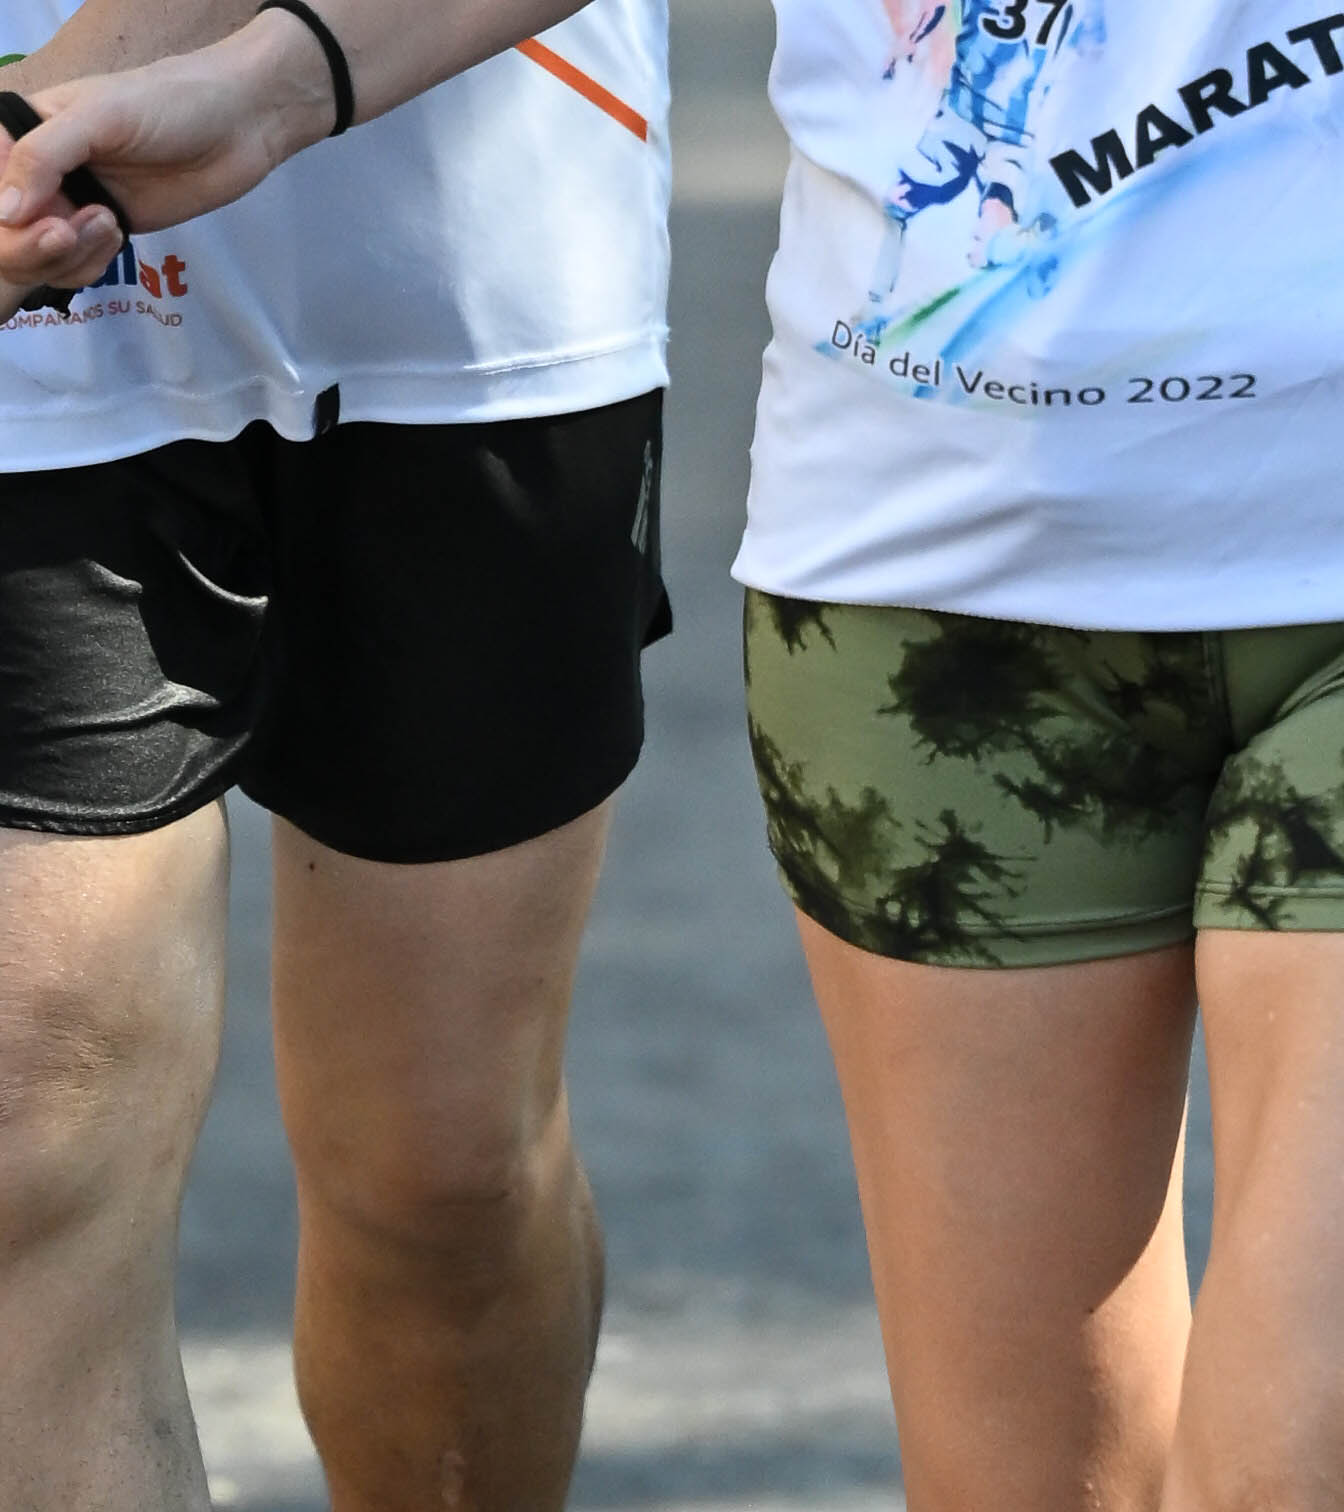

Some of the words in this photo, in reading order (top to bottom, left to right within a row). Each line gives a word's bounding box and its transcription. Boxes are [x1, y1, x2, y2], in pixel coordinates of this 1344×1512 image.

[108, 300, 130, 316] SU
[831, 320, 876, 365] Día
[889, 352, 940, 386] del
[956, 365, 1106, 406] Vecino
[1127, 374, 1256, 404] 2022
